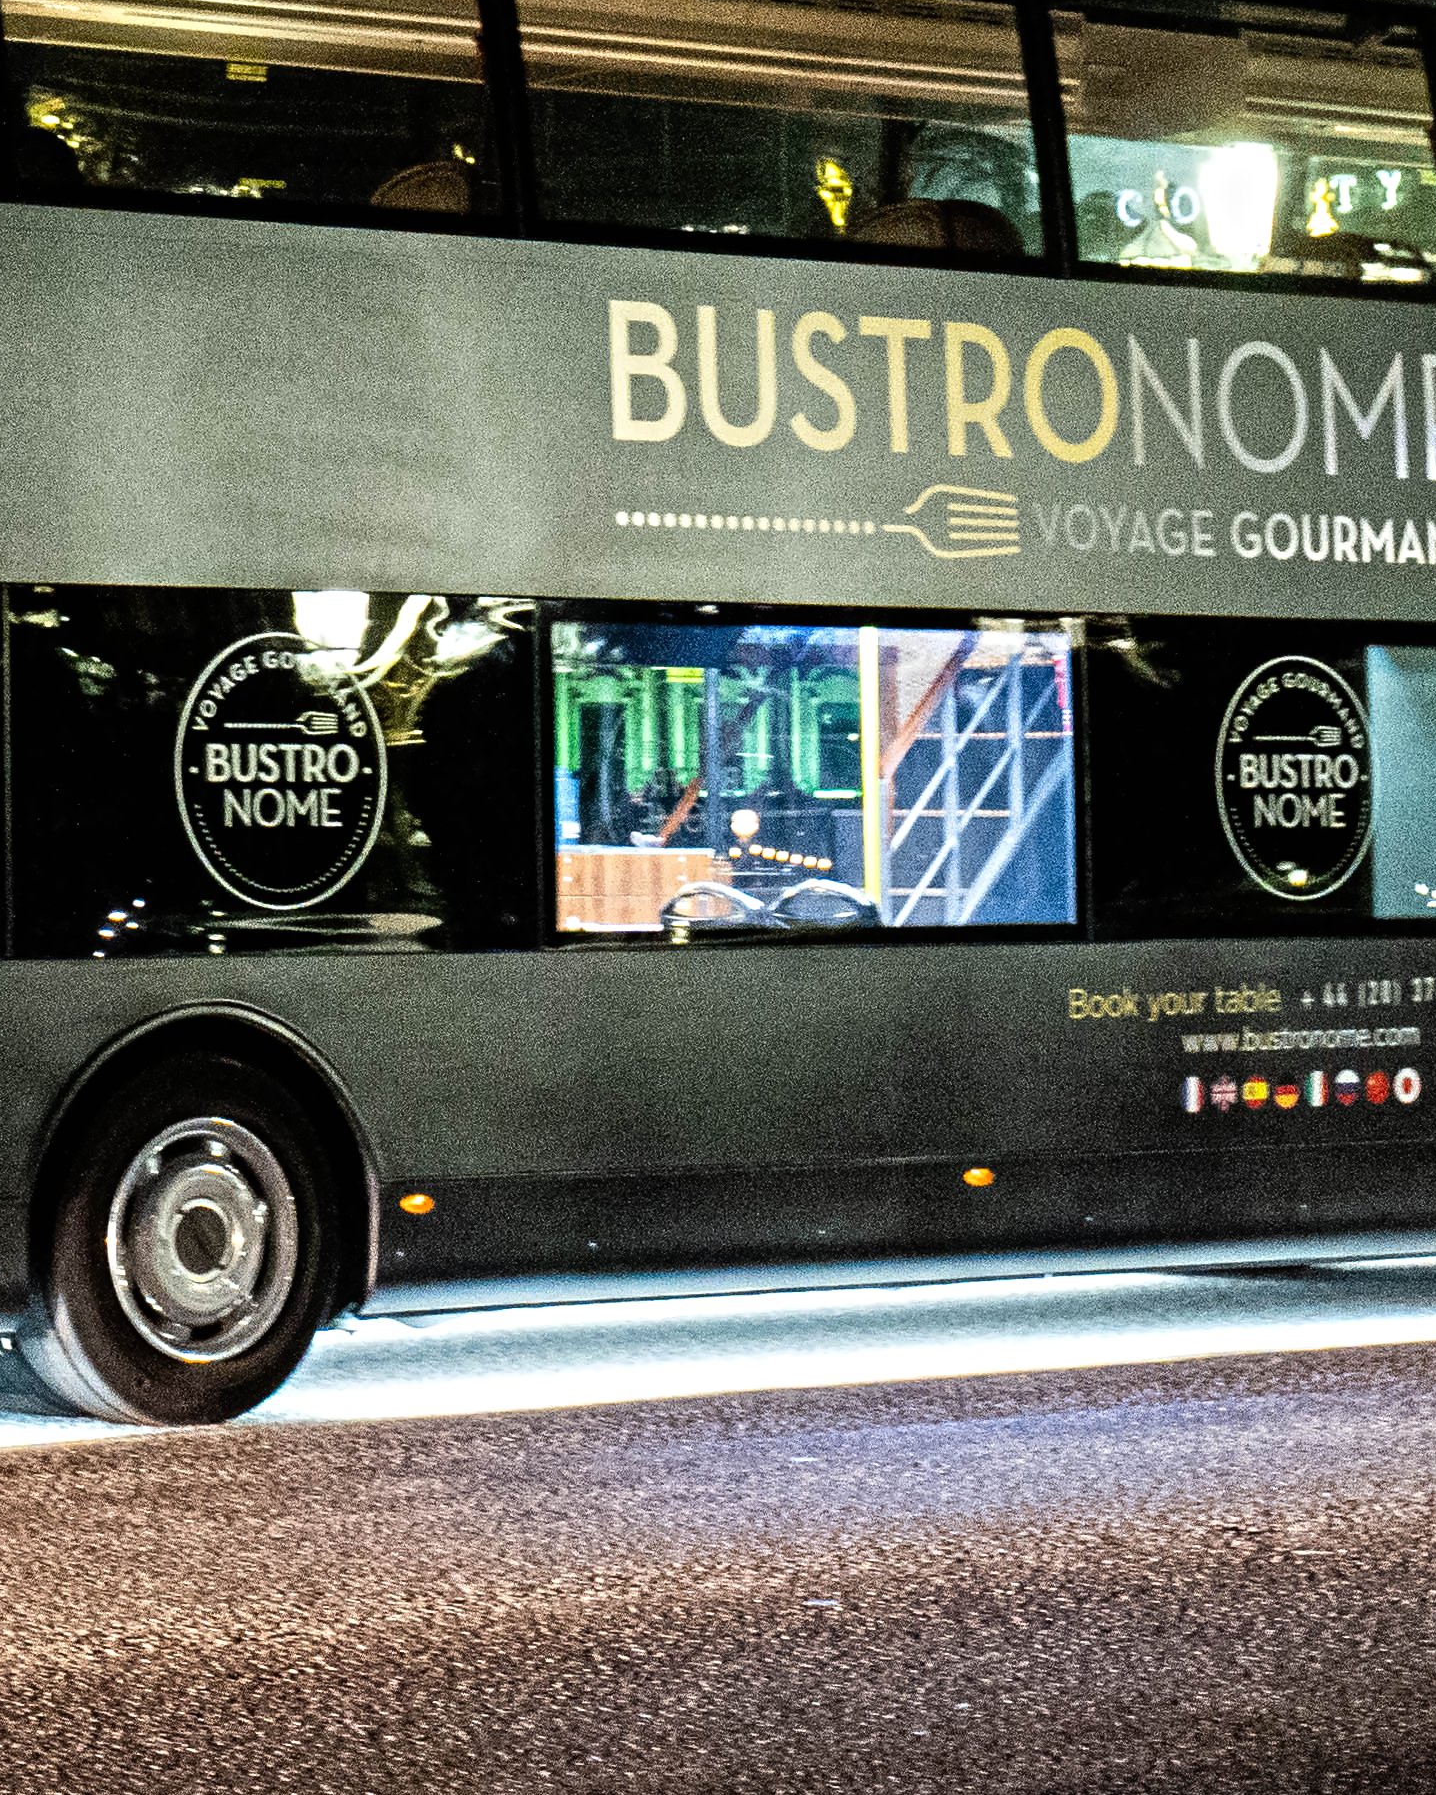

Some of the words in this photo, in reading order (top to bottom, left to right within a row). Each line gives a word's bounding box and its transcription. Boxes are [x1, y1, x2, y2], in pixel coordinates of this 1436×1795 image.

[1033, 503, 1215, 558] VOYAGE
[191, 654, 260, 732] VOYAGE
[205, 743, 359, 783] BUSTRO
[1239, 753, 1359, 789] BUSTRO
[223, 788, 342, 828] NOME
[1253, 793, 1346, 828] NOME
[1069, 986, 1139, 1020] Book
[1147, 991, 1207, 1022] your
[1214, 982, 1282, 1014] table
[1181, 1025, 1421, 1053] www.bustronome.com
